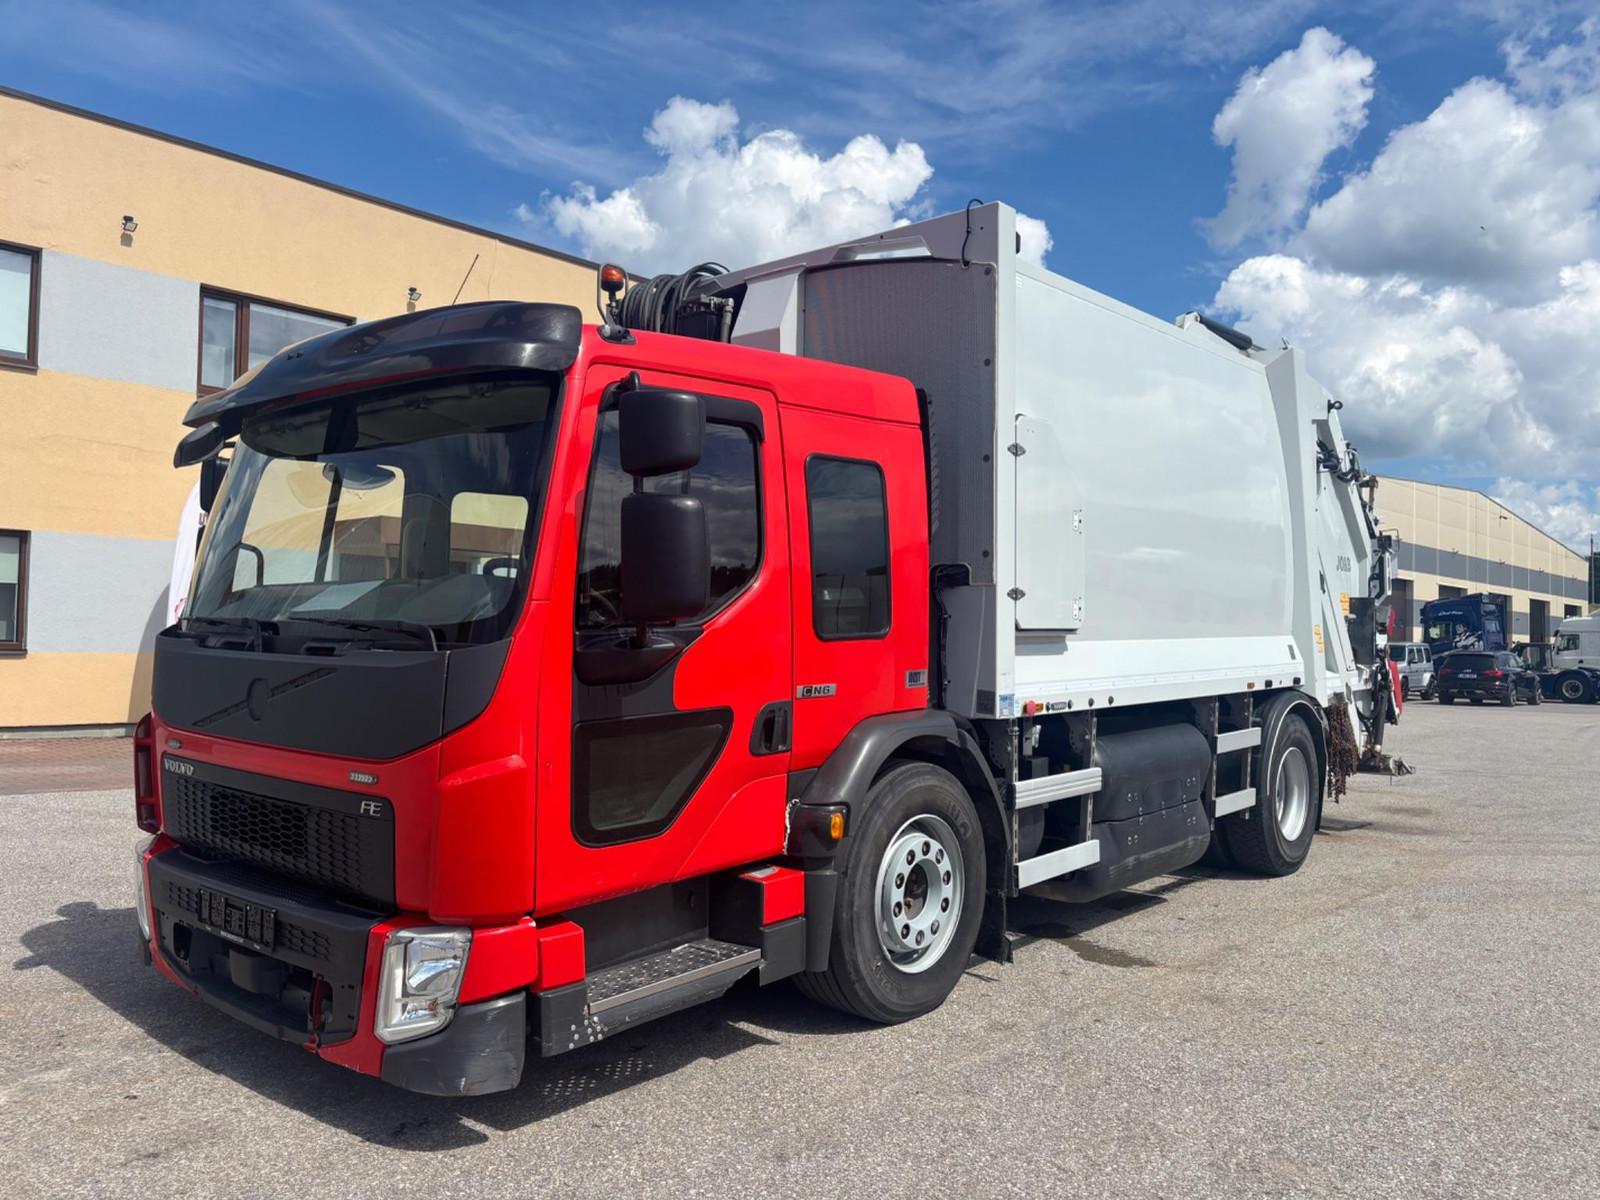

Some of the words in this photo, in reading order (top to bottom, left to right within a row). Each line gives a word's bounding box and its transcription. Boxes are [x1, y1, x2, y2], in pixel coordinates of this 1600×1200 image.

[801, 686, 830, 697] CNG
[164, 758, 194, 776] VOLVO
[360, 800, 383, 817] FE
